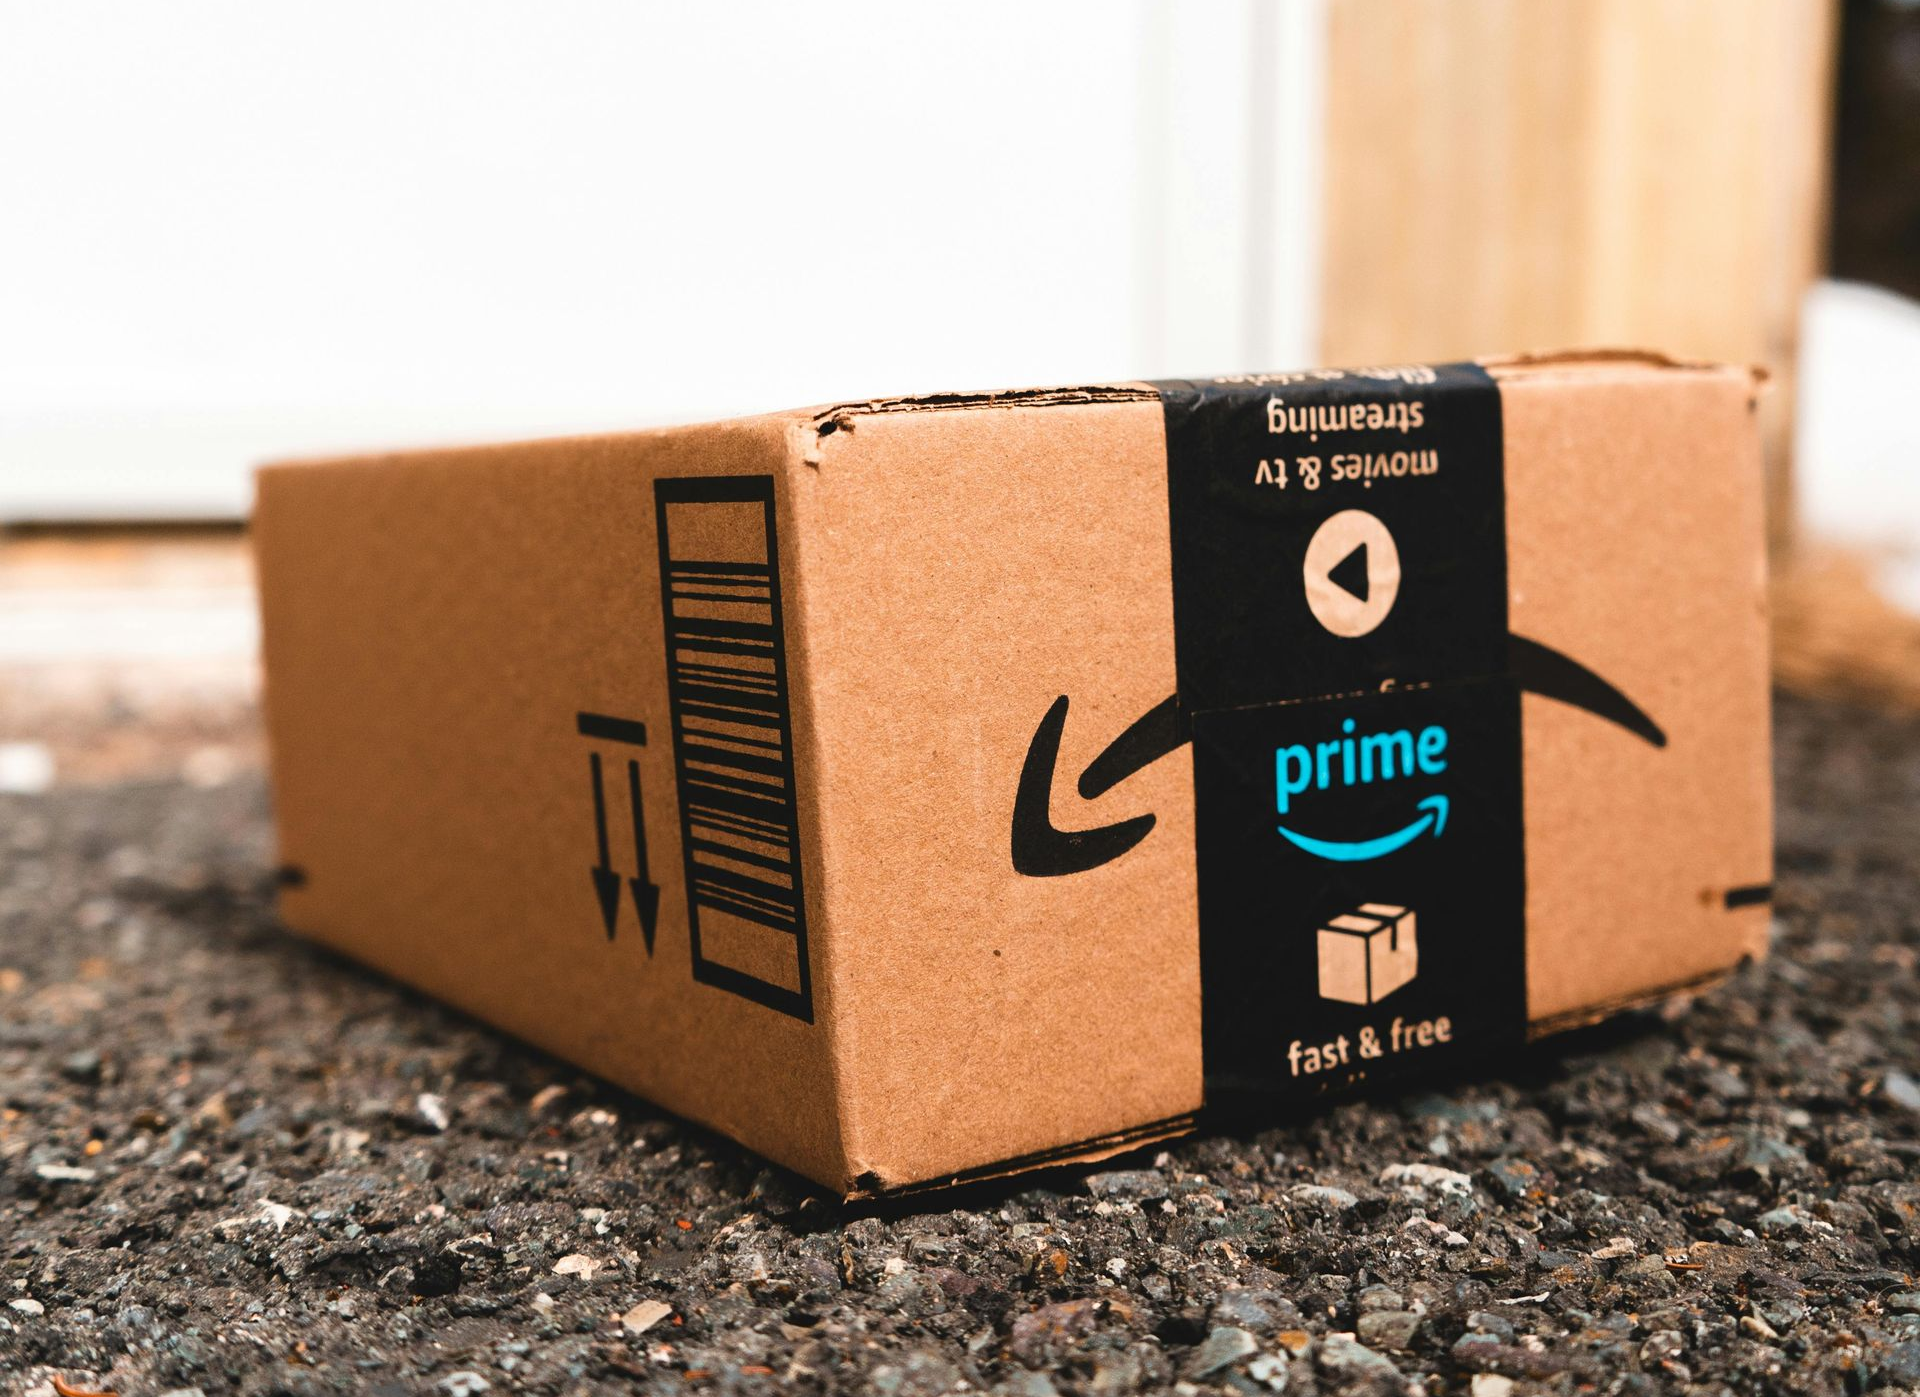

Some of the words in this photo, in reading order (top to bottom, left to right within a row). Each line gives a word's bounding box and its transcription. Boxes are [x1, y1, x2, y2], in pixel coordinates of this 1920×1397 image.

[1266, 397, 1426, 443] streaming
[1254, 458, 1289, 490] tv
[1295, 455, 1322, 491] &
[1330, 449, 1439, 489] movies
[1275, 718, 1449, 815] prime
[1287, 1036, 1350, 1077] fast
[1359, 1025, 1383, 1059] &
[1390, 1016, 1452, 1052] free
